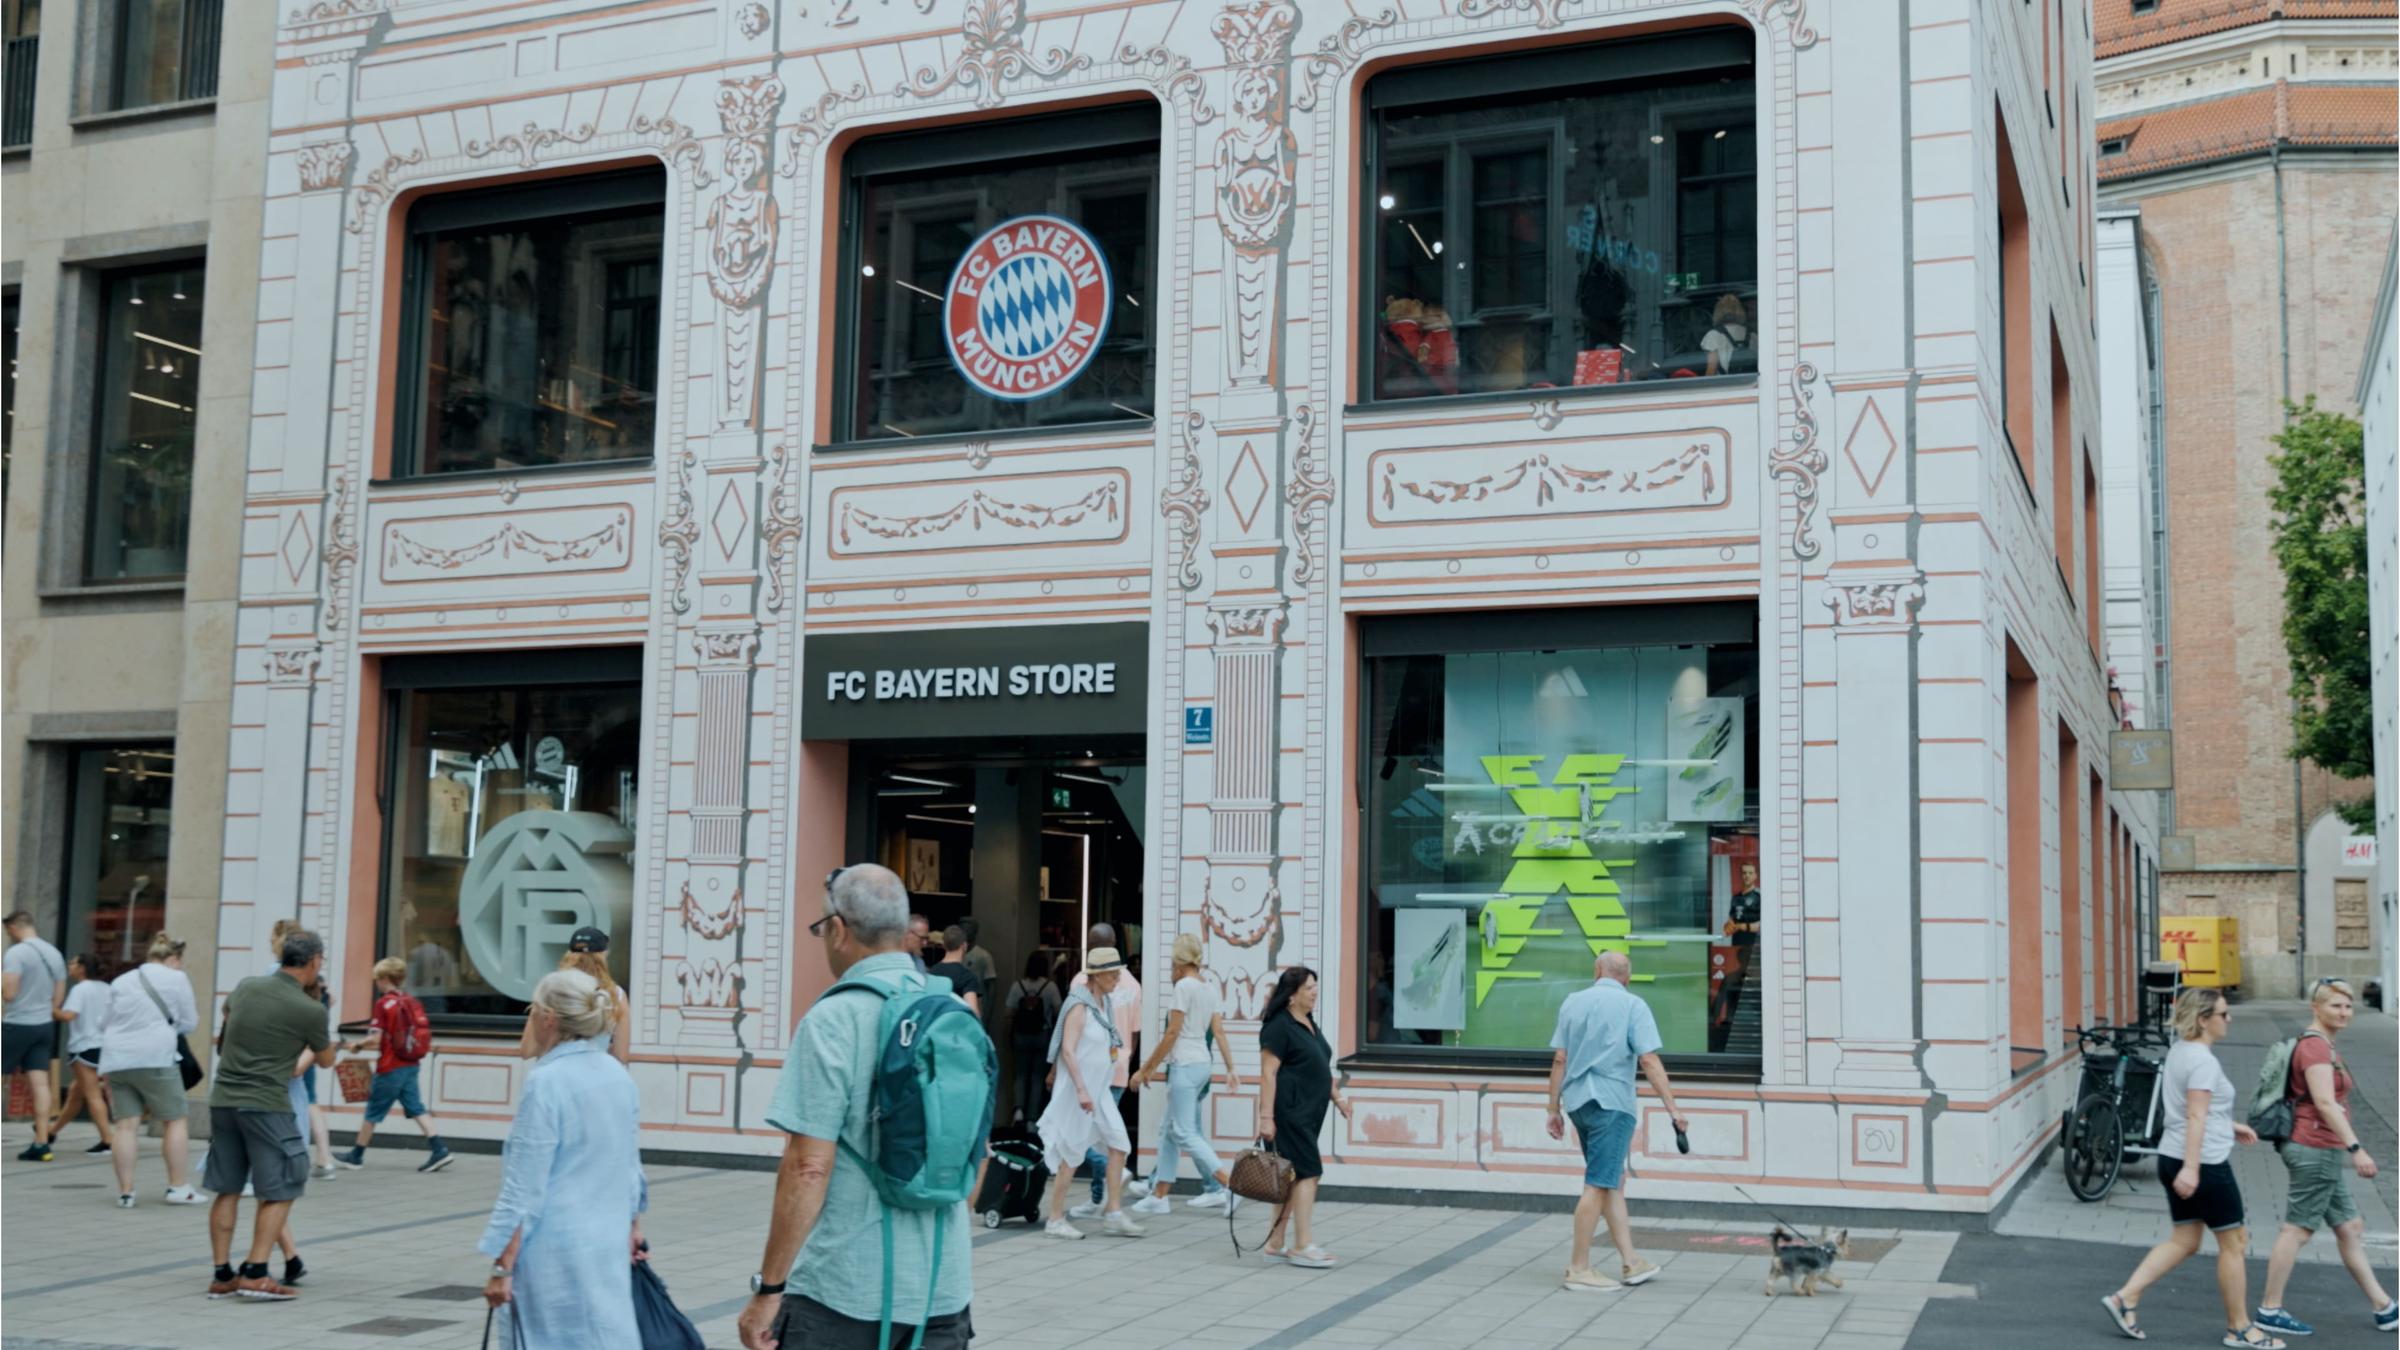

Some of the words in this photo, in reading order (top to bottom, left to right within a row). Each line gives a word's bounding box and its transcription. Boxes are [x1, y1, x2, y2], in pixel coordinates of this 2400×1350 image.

[957, 255, 991, 297] FC
[992, 224, 1099, 289] BAYERN
[956, 319, 1096, 390] MÜNCHEN
[827, 670, 866, 700] FC
[874, 666, 999, 699] BAYERN
[1008, 662, 1116, 696] STORE
[1193, 709, 1204, 726] 7
